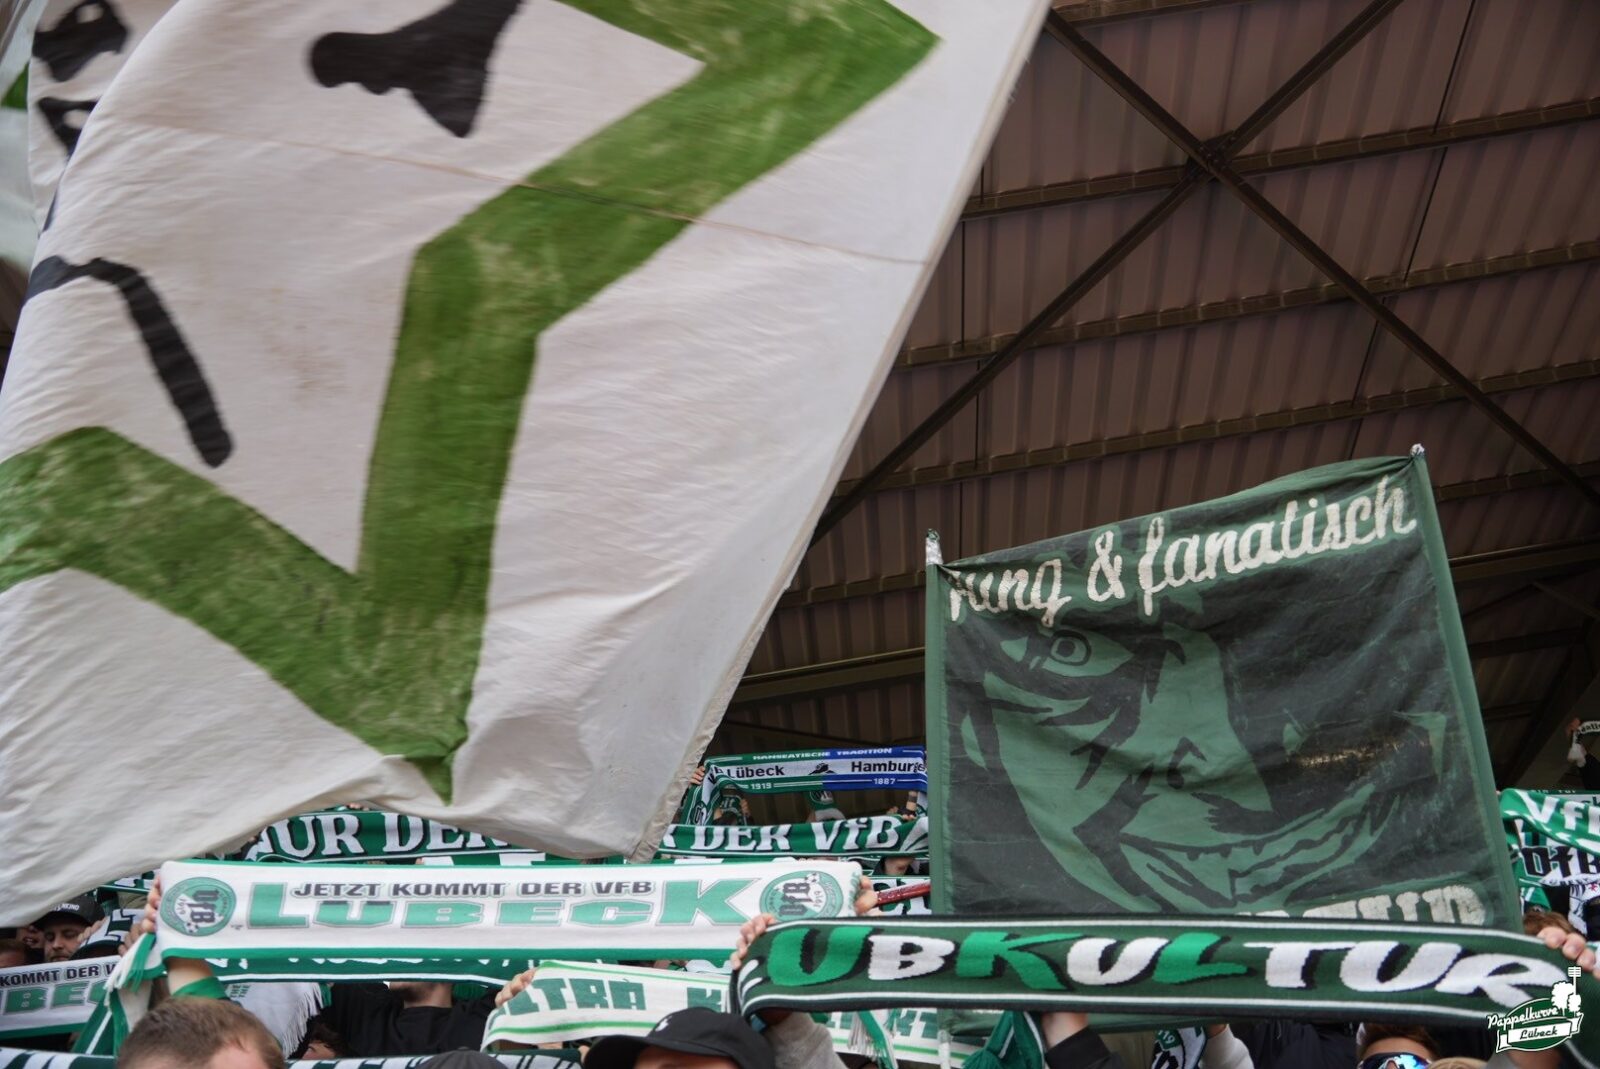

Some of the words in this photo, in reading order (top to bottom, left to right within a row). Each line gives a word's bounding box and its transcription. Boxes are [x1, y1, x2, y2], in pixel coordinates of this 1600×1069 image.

[1087, 530, 1124, 602] &
[1138, 475, 1418, 616] fanatisch
[837, 748, 893, 757] TRADITION
[727, 765, 785, 779] Lübeck
[751, 782, 772, 790] 1919
[874, 778, 896, 786] 1887
[690, 825, 793, 850] DER
[811, 817, 903, 850] VfB
[294, 882, 381, 897] JETZT
[392, 882, 505, 897] KOMMT
[520, 881, 582, 896] DER
[594, 881, 652, 895] VFB
[0, 970, 60, 987] KOMMT
[66, 965, 99, 979] DER
